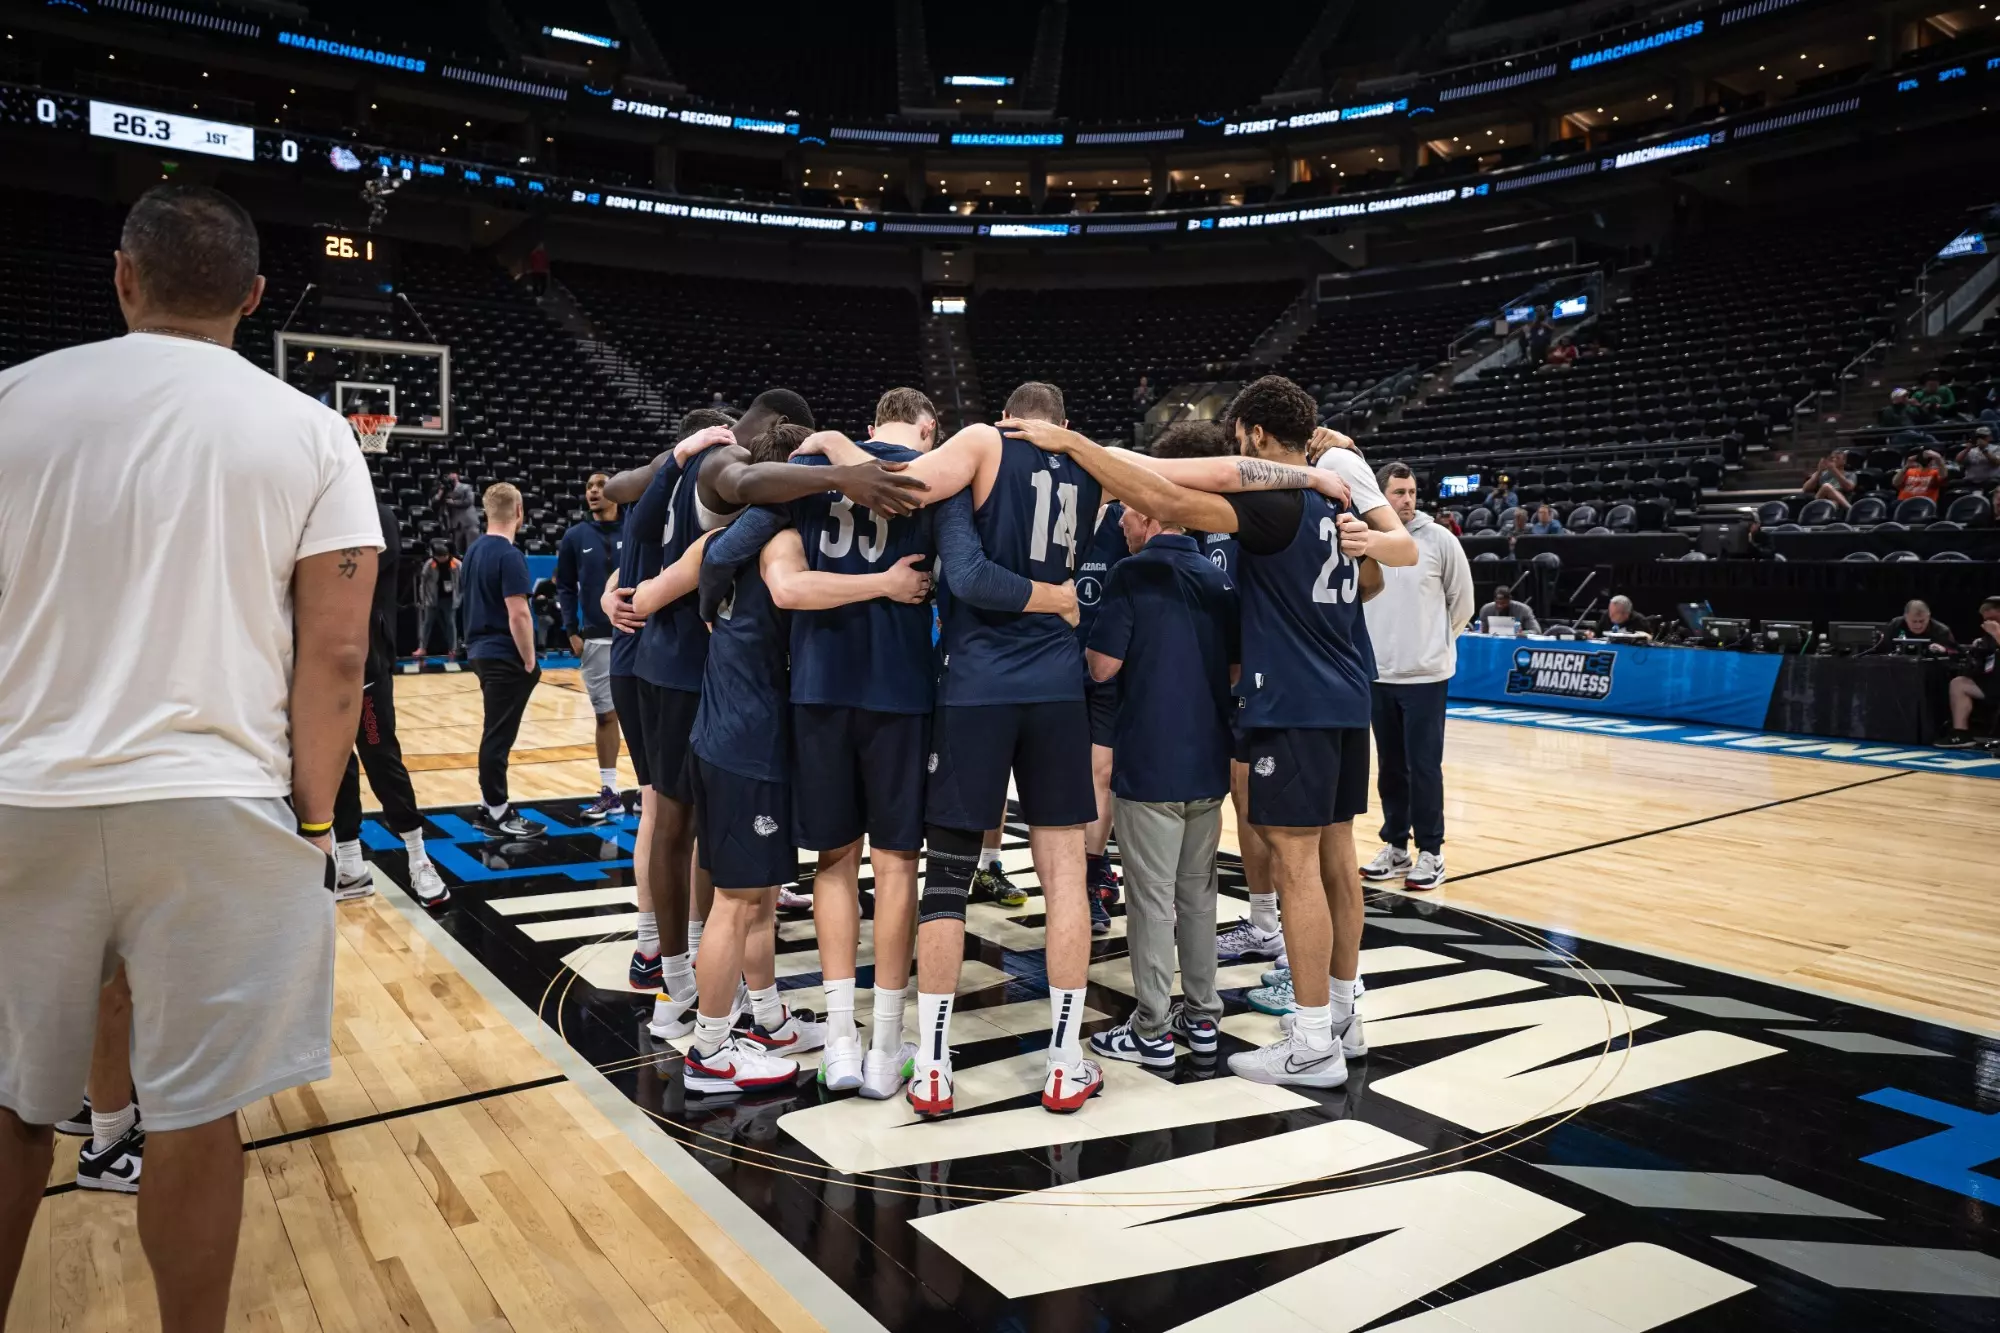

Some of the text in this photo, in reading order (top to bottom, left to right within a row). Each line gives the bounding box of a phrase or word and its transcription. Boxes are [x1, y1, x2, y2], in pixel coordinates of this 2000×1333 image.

[278, 31, 426, 72] #MARCHMADNESS
[1570, 20, 1704, 70] #MARCHMADNESS
[36, 98, 56, 123] 0
[627, 101, 667, 119] FIRST
[680, 110, 731, 127] SECOND
[733, 117, 785, 134] ROUNDS
[1239, 119, 1277, 134] FIRST
[1289, 110, 1339, 128] SECOND
[1341, 102, 1393, 120] ROUNDS
[112, 112, 229, 145] 26.3 1ST
[951, 134, 1063, 145] #MARCHMADNESS
[281, 139, 299, 163] 0
[1615, 133, 1711, 169] MARCHMADNESS
[402, 168, 412, 181] 0
[605, 195, 637, 208] 2024
[654, 202, 690, 217] MEN'S
[690, 204, 759, 224] BASKETBALL
[760, 213, 846, 231] CHAMPIONSHIP
[1218, 215, 1248, 228] 2024
[1264, 210, 1297, 224] MEN'S
[1299, 202, 1366, 221] BASKETBALL
[1367, 189, 1456, 213] CHAMPIONSHIP
[325, 235, 373, 261] 26.1
[1084, 582, 1093, 599] 4
[1531, 651, 1586, 673] MARCH
[1535, 671, 1610, 693] MADNESS
